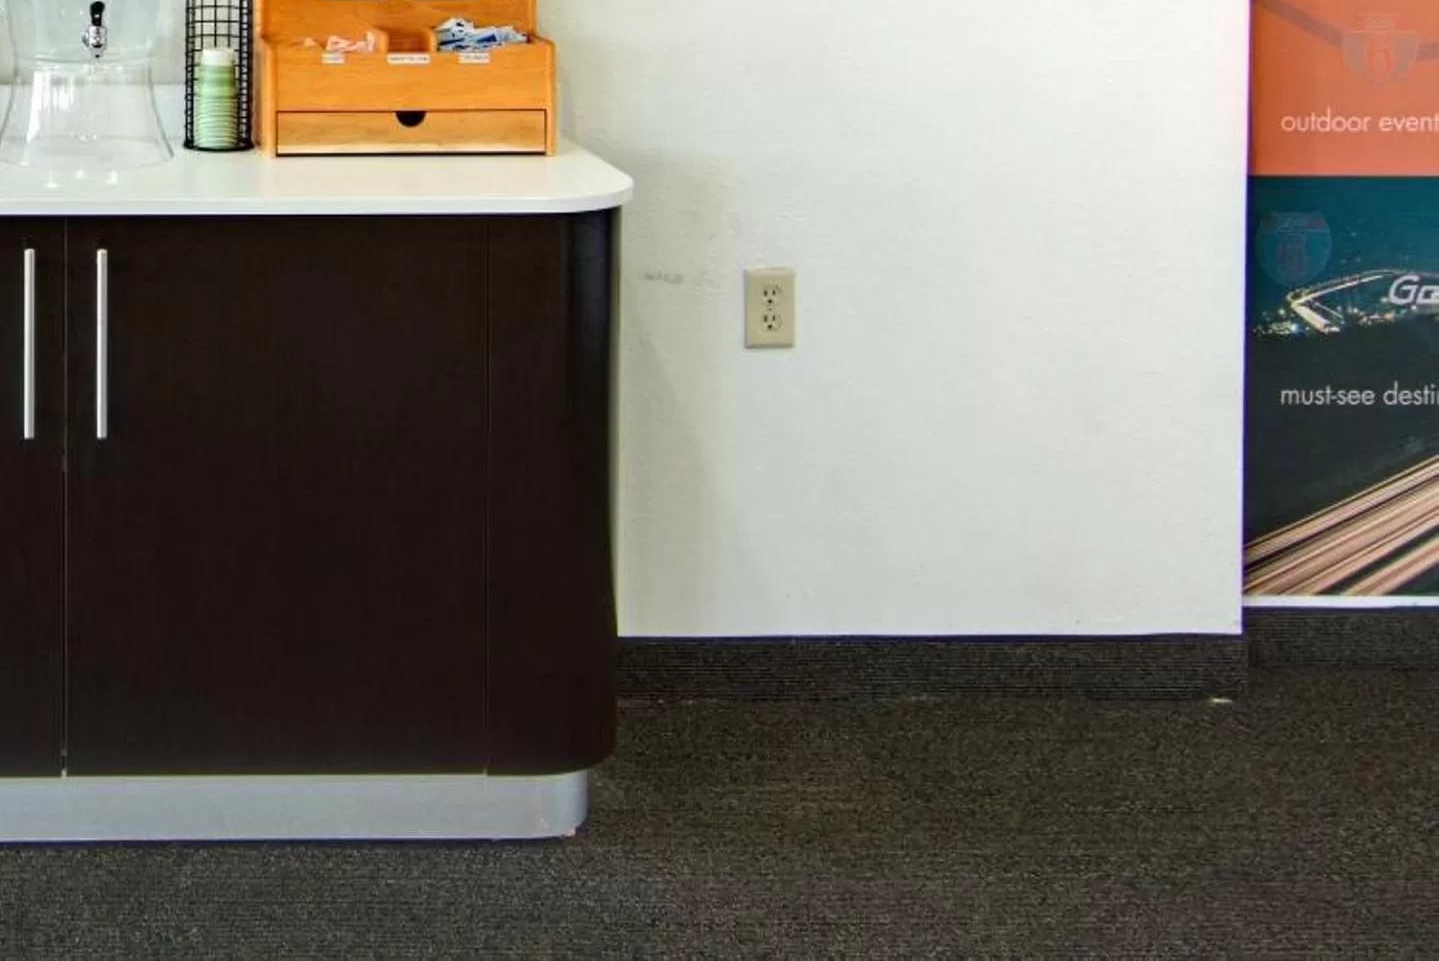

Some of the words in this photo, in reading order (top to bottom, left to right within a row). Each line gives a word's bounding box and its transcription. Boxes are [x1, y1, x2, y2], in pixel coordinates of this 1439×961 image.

[1281, 106, 1371, 132] outdoor
[1280, 384, 1375, 406] must-see
[1383, 379, 1439, 406] desti
